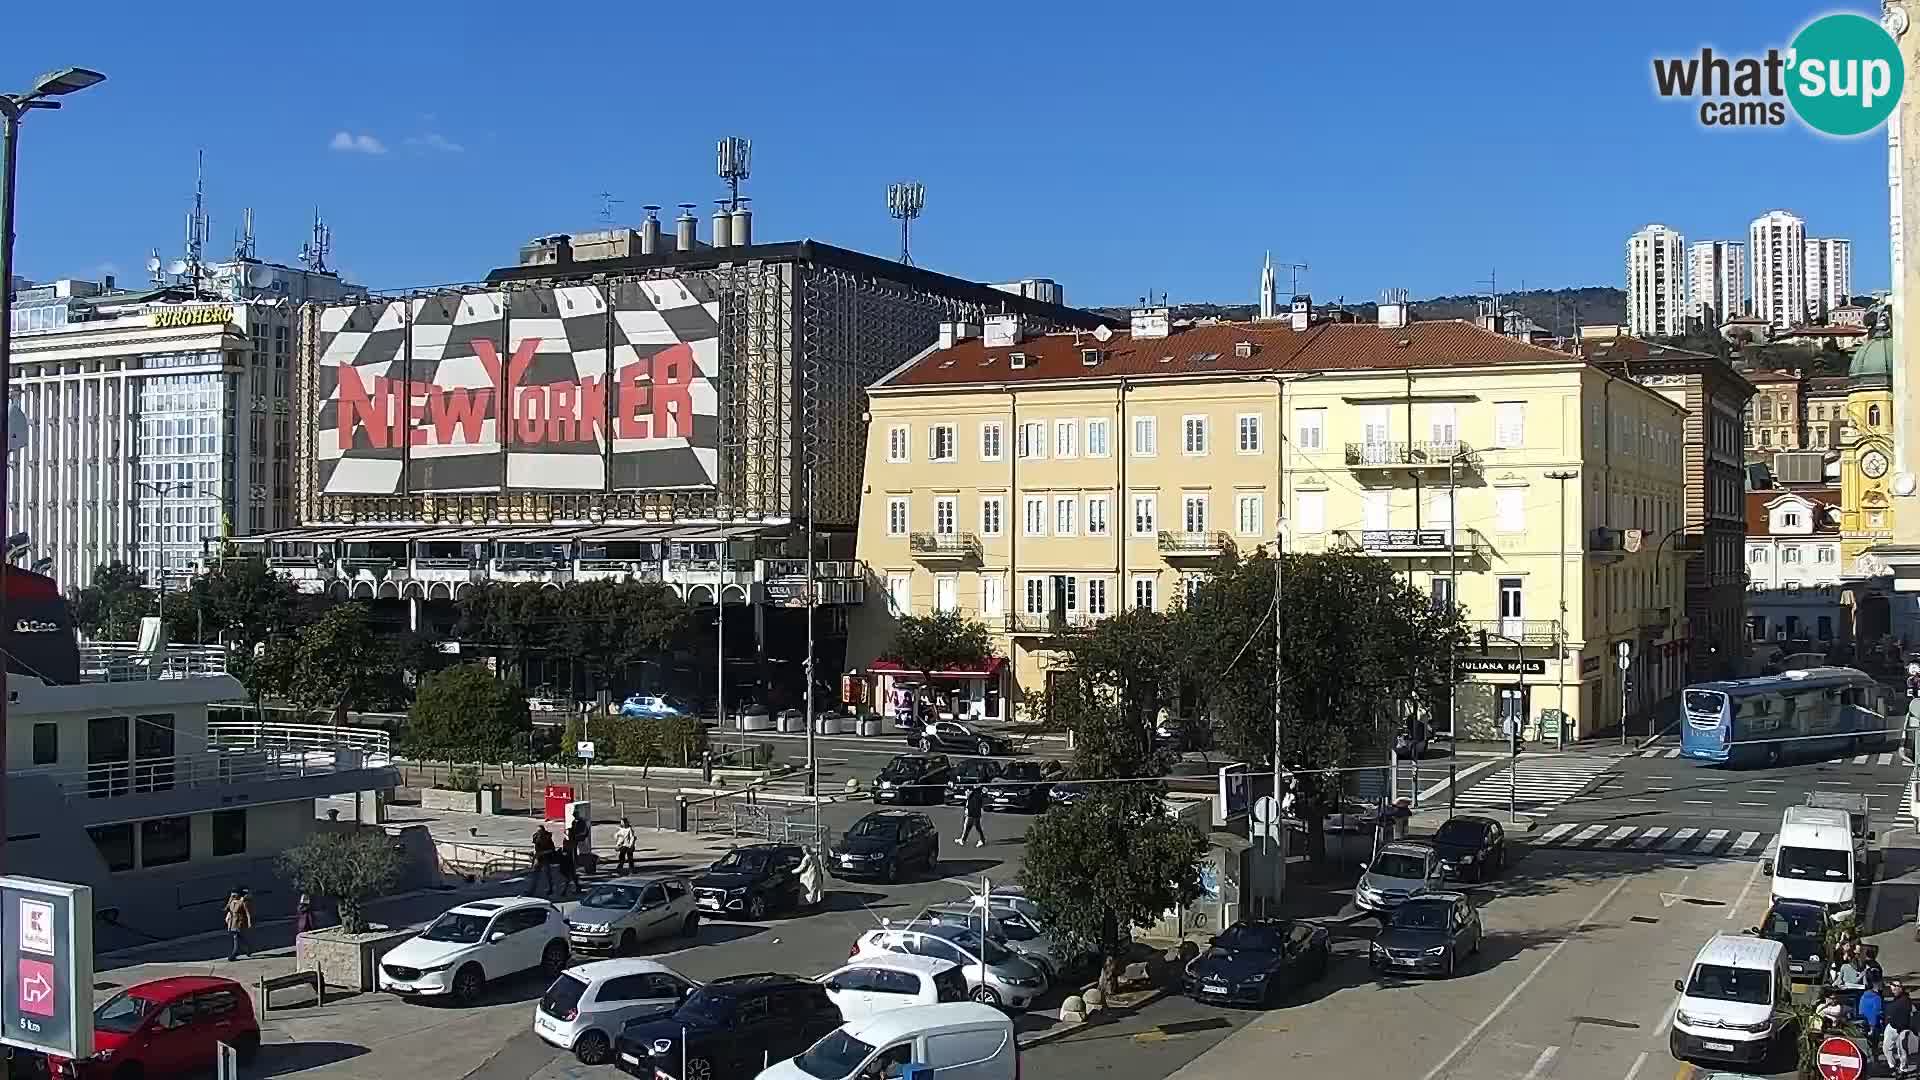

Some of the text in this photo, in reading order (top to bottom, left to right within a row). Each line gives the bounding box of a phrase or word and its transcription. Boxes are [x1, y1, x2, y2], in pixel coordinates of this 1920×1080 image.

[1458, 662, 1540, 672] JULIANA NAILS
[20, 1018, 41, 1032] 5 km
